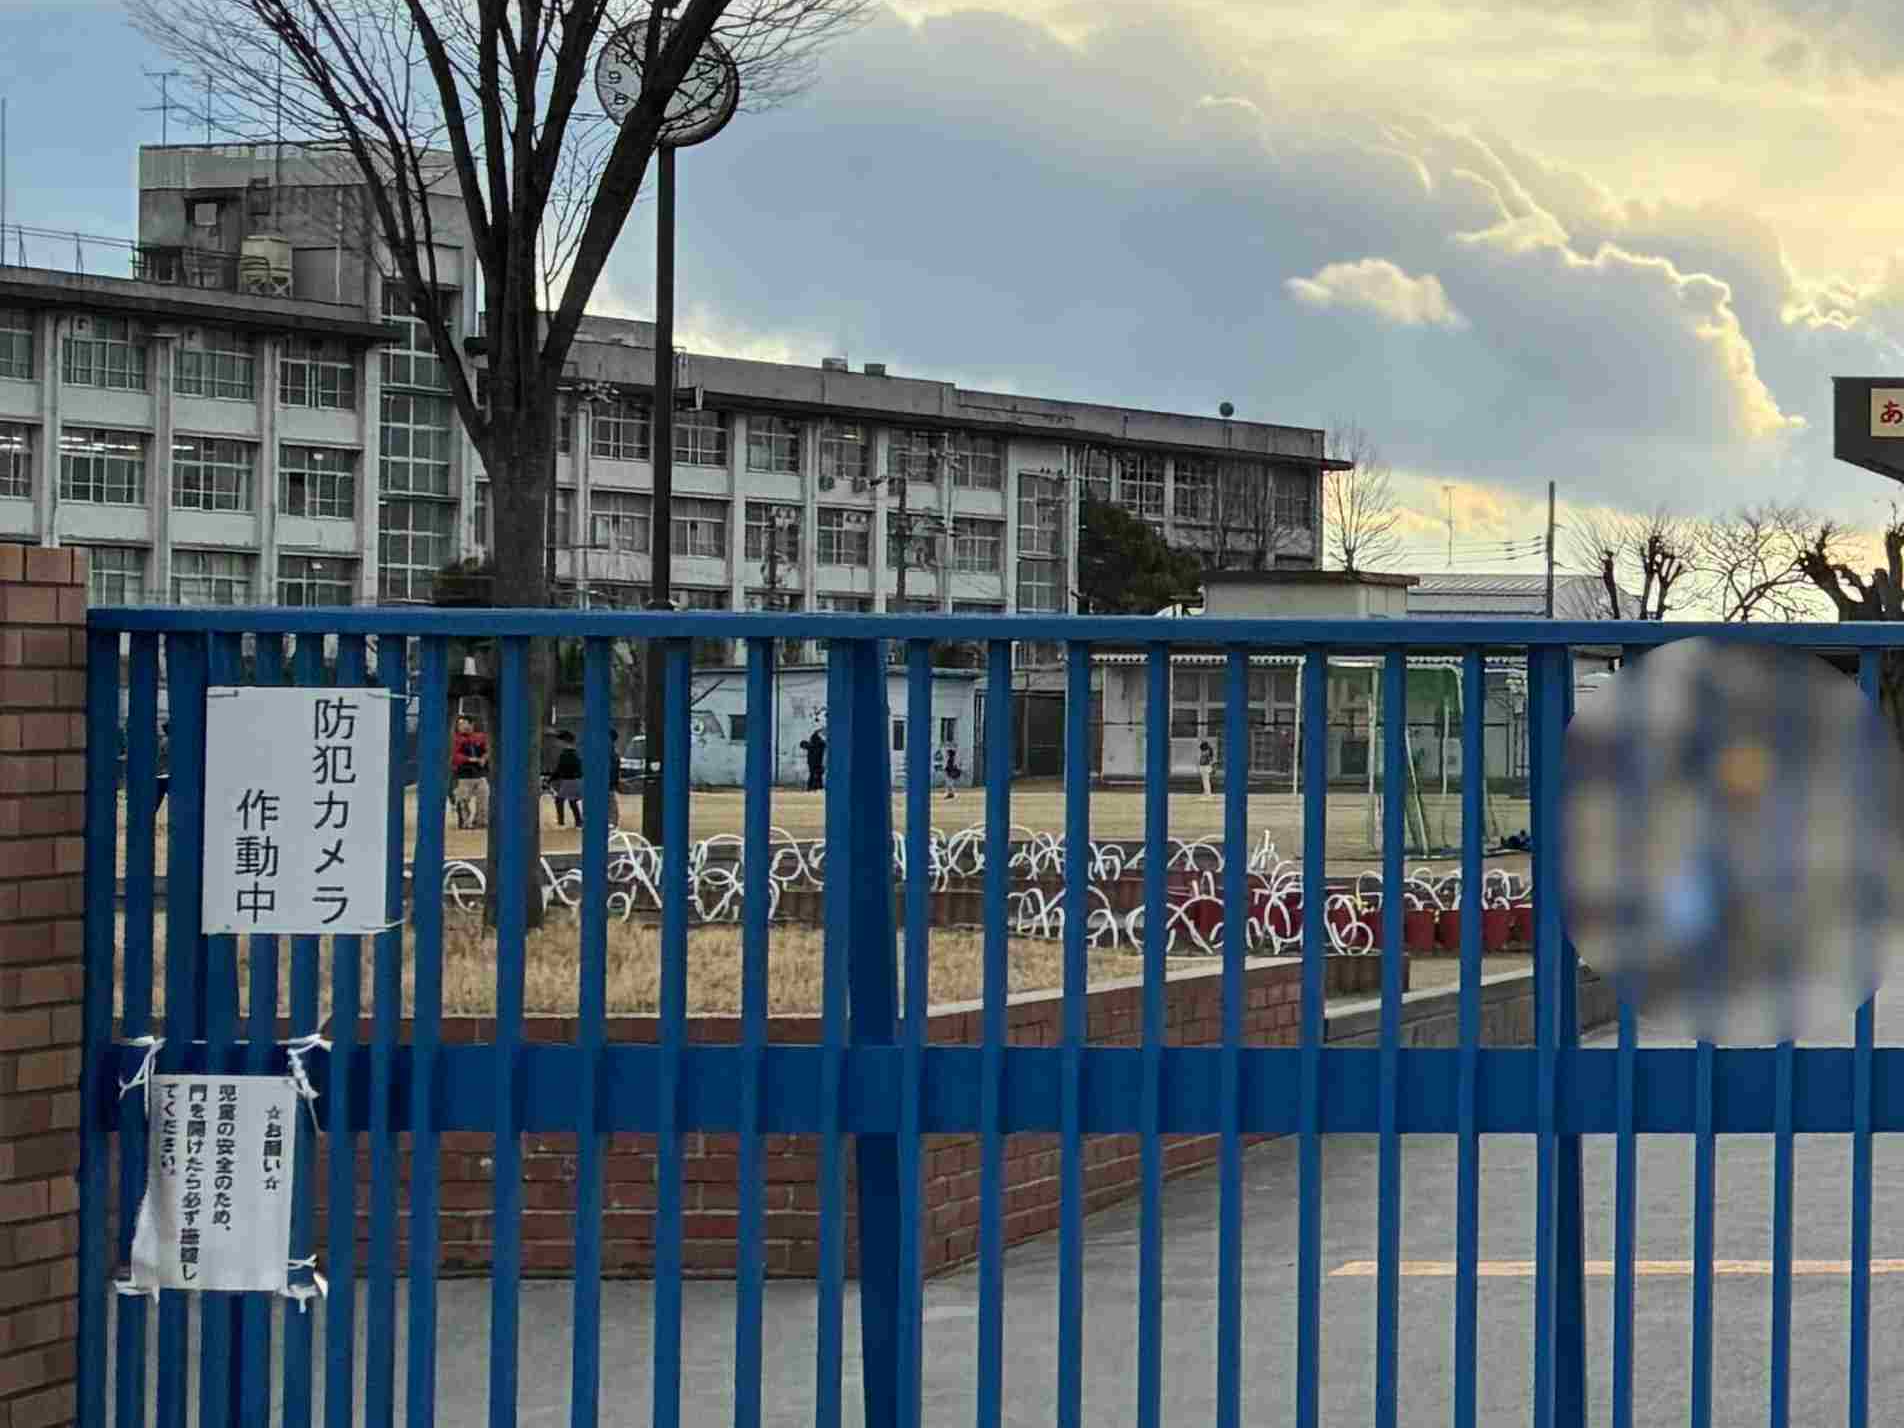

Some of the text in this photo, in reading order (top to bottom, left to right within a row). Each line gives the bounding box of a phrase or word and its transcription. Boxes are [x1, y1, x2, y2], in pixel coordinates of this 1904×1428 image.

[234, 788, 280, 925] 作動中
[312, 698, 359, 925] 防犯カメラ
